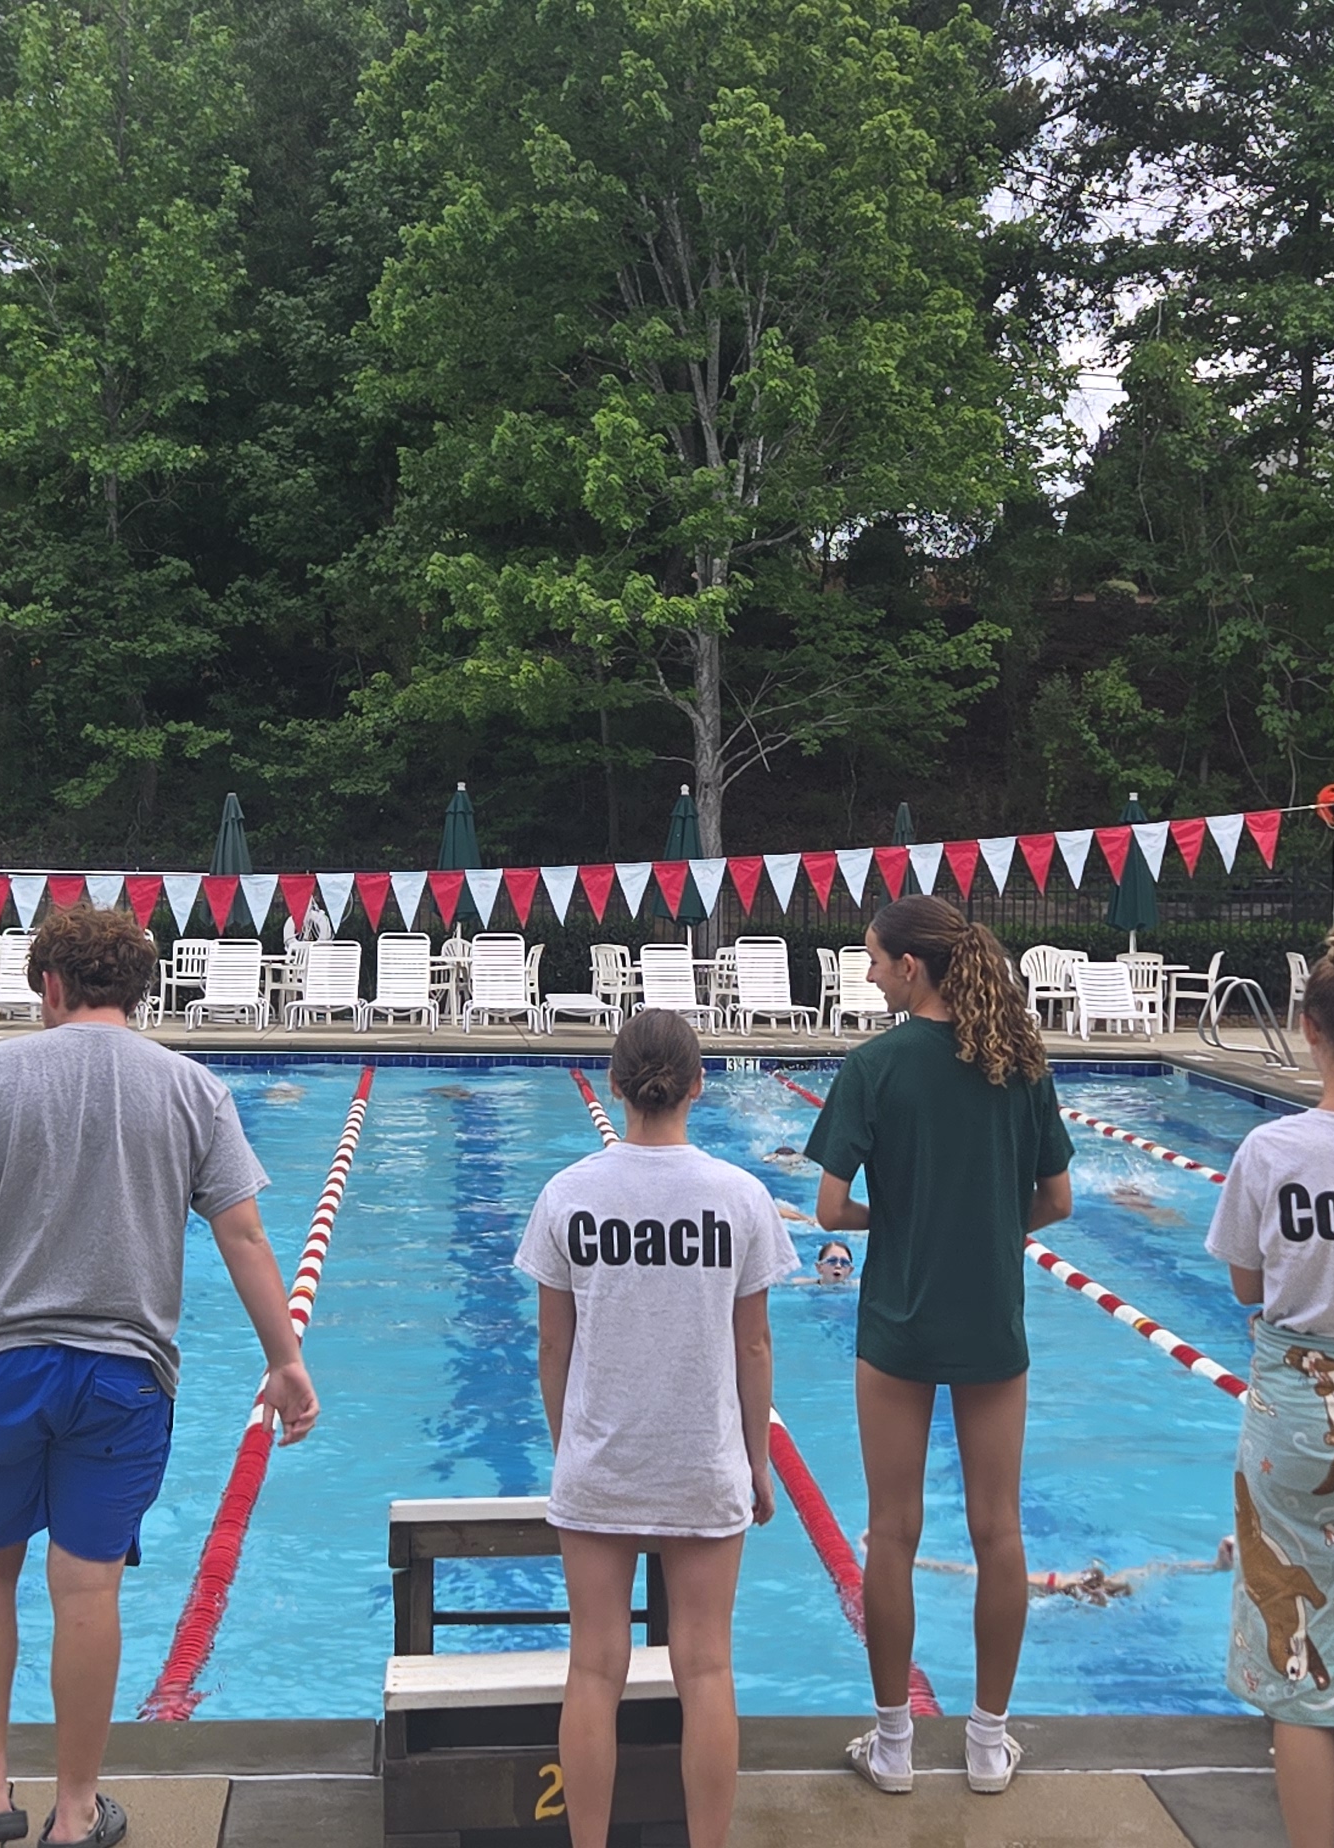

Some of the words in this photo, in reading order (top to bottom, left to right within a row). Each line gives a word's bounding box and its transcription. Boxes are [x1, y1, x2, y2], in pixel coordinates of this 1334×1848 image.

[744, 1058, 759, 1070] FT
[568, 1210, 732, 1268] Coach
[535, 1763, 565, 1820] 2
